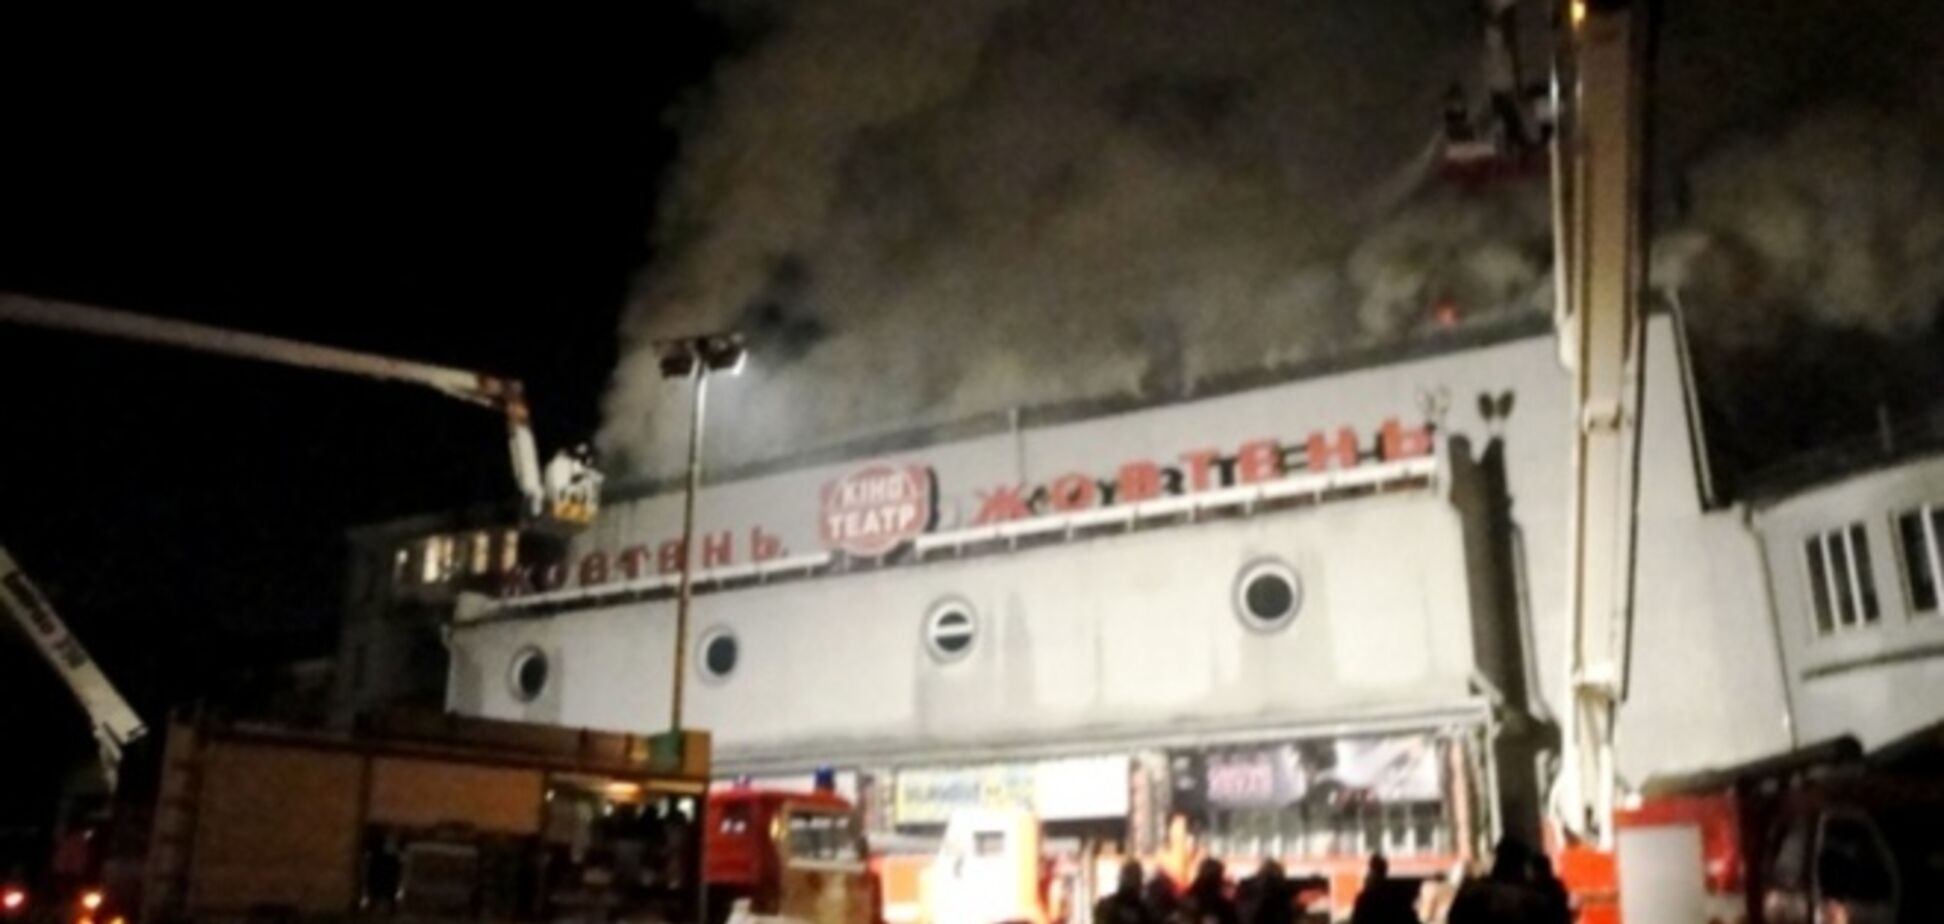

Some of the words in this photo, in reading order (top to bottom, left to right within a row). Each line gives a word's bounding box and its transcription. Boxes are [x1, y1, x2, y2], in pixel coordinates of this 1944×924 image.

[974, 418, 1434, 524] ЖОВТЕНЬ
[841, 477, 902, 505] КІНО
[828, 503, 915, 540] ТЕАТР
